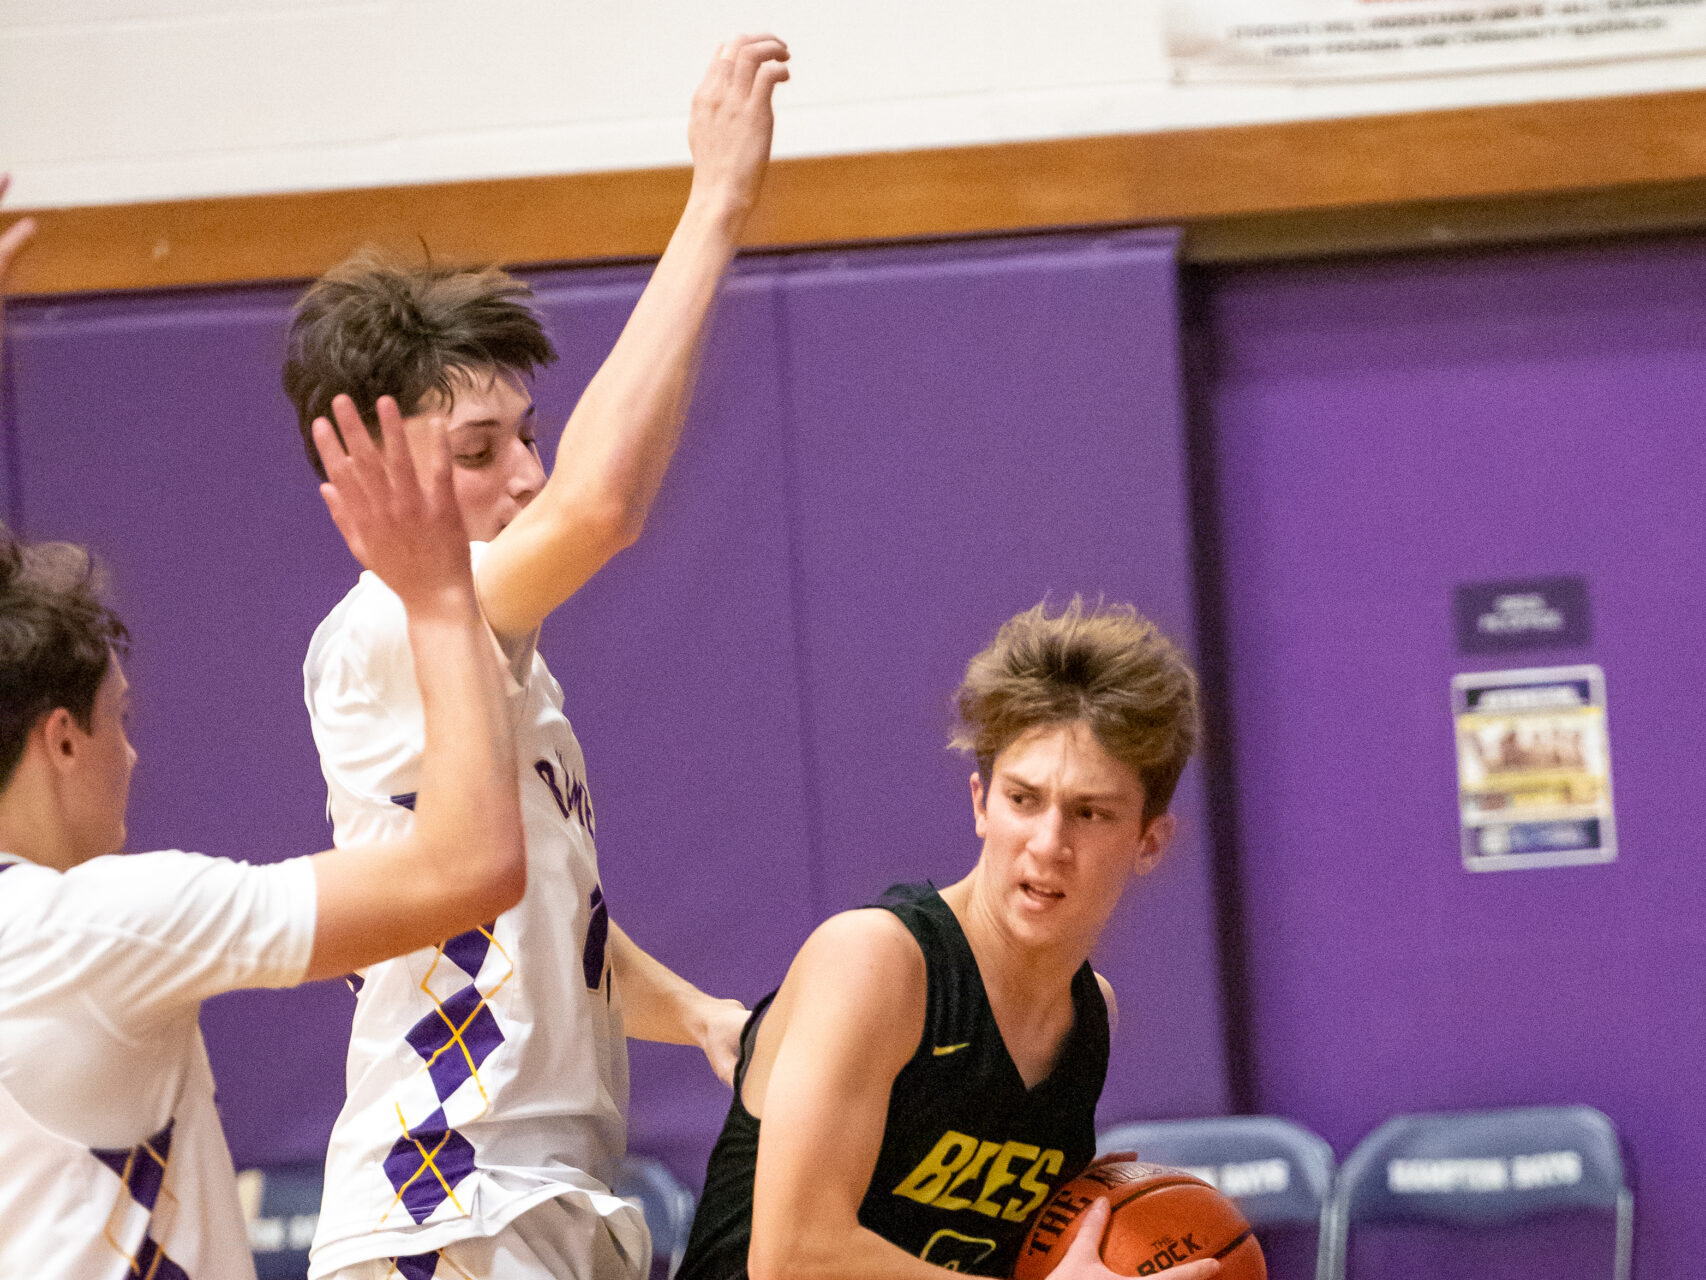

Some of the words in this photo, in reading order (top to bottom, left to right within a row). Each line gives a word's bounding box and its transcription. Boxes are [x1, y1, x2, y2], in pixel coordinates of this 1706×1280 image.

[892, 1129, 1065, 1223] BEES
[1137, 1233, 1203, 1277] ROCK
[1151, 1235, 1174, 1250] THE
